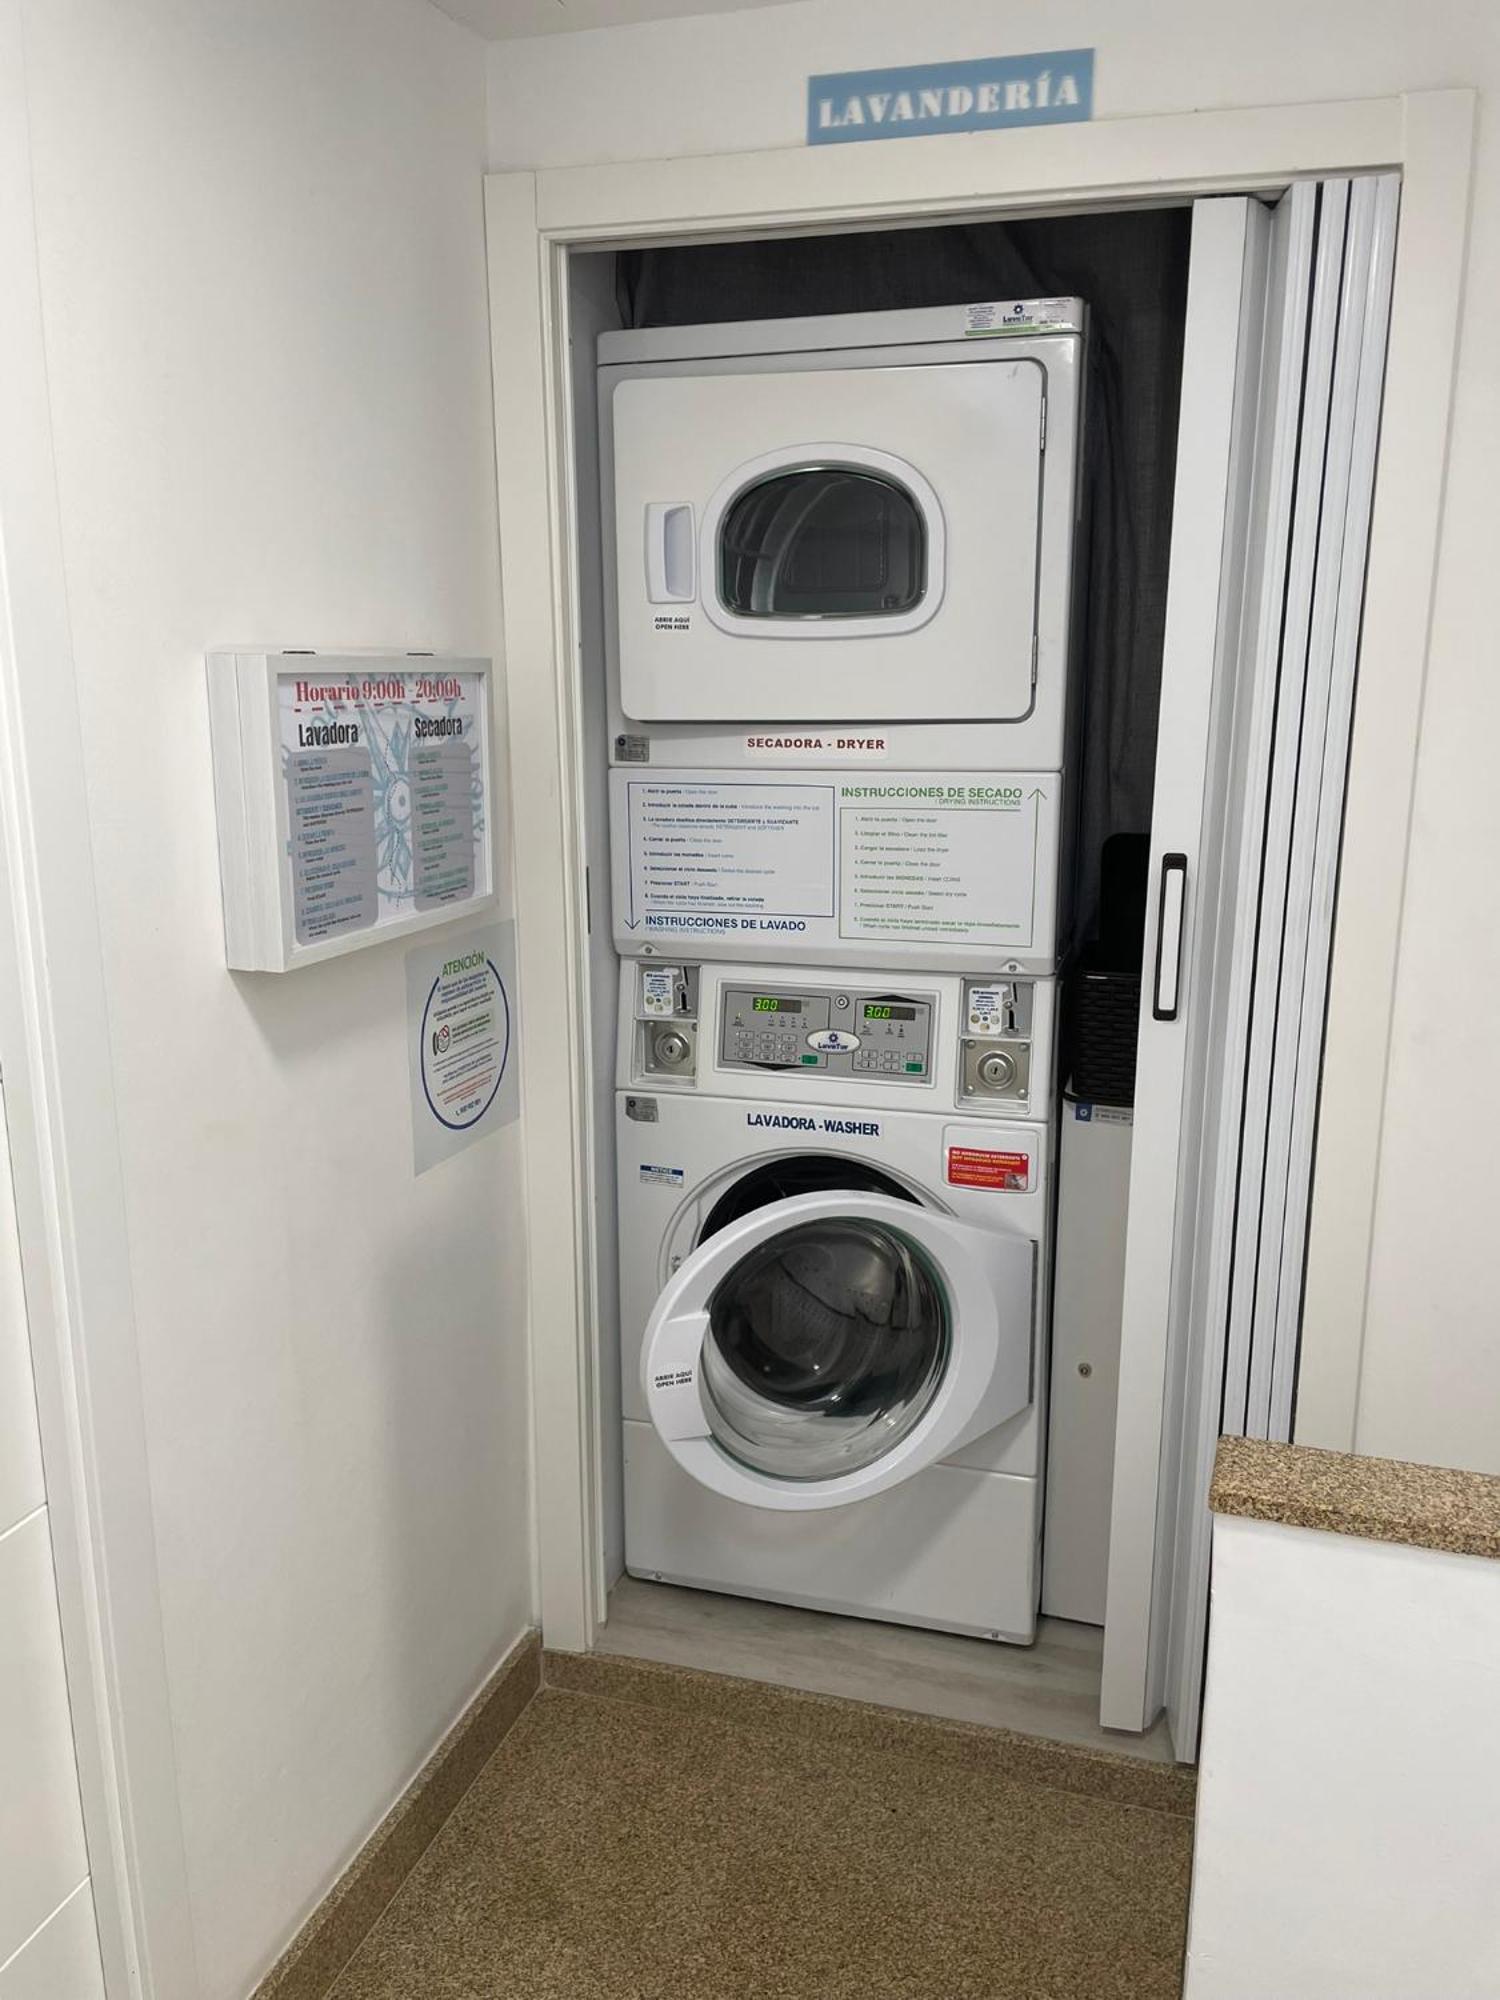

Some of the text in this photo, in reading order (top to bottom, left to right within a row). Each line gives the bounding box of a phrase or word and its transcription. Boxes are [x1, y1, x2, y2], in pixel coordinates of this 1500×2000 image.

[819, 70, 1079, 128] LAVANDERÍA
[295, 681, 360, 702] Horario
[362, 679, 405, 700] 9:00h
[415, 678, 461, 699] 20:00h
[298, 721, 359, 747] Lavadora
[414, 716, 462, 738] Secadora
[747, 737, 822, 748] SECADORA
[837, 739, 885, 749] DRYER
[841, 787, 1022, 798] INSTRUCCIONES DE SECADO
[645, 916, 806, 931] INSTRUCCIONES DE LAVADO
[442, 950, 484, 977] ATENCIÓN
[747, 1112, 816, 1130] LAVADORA
[824, 1120, 880, 1136] WASHER
